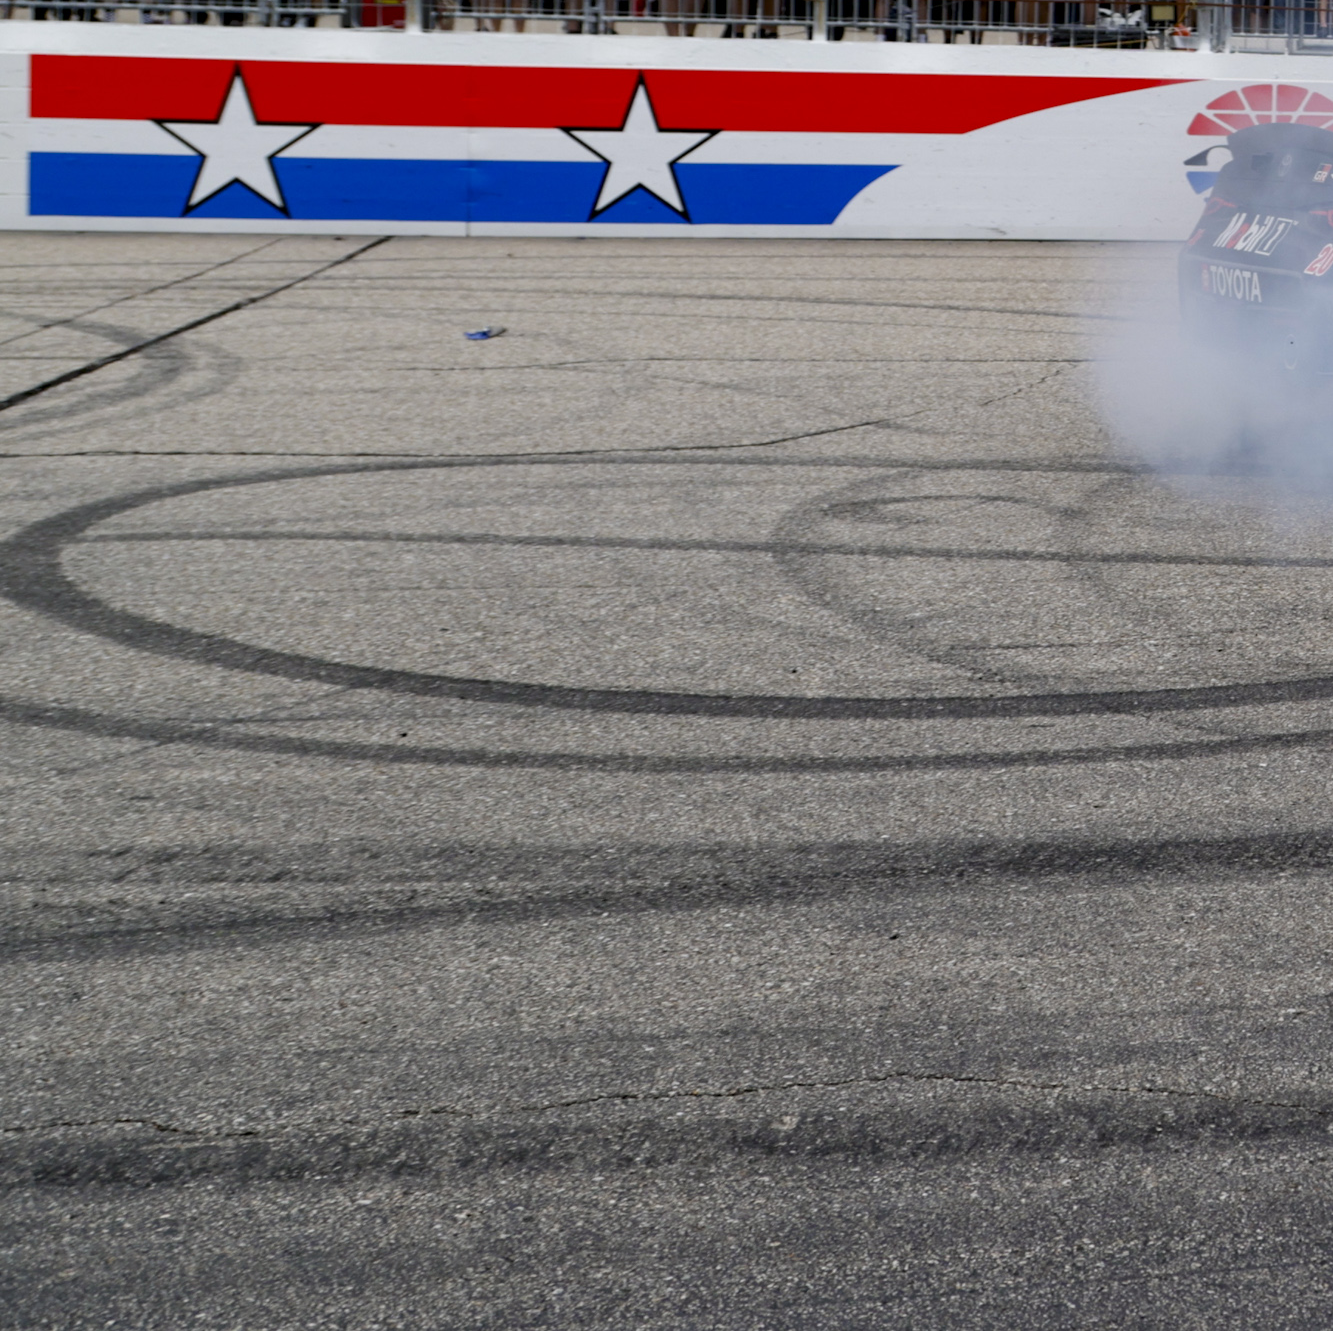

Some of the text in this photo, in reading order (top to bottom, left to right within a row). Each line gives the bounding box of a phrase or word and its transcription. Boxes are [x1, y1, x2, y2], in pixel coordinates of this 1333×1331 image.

[1314, 170, 1329, 182] GR
[1212, 212, 1275, 253] Mobil
[1209, 265, 1262, 303] TOYOTA
